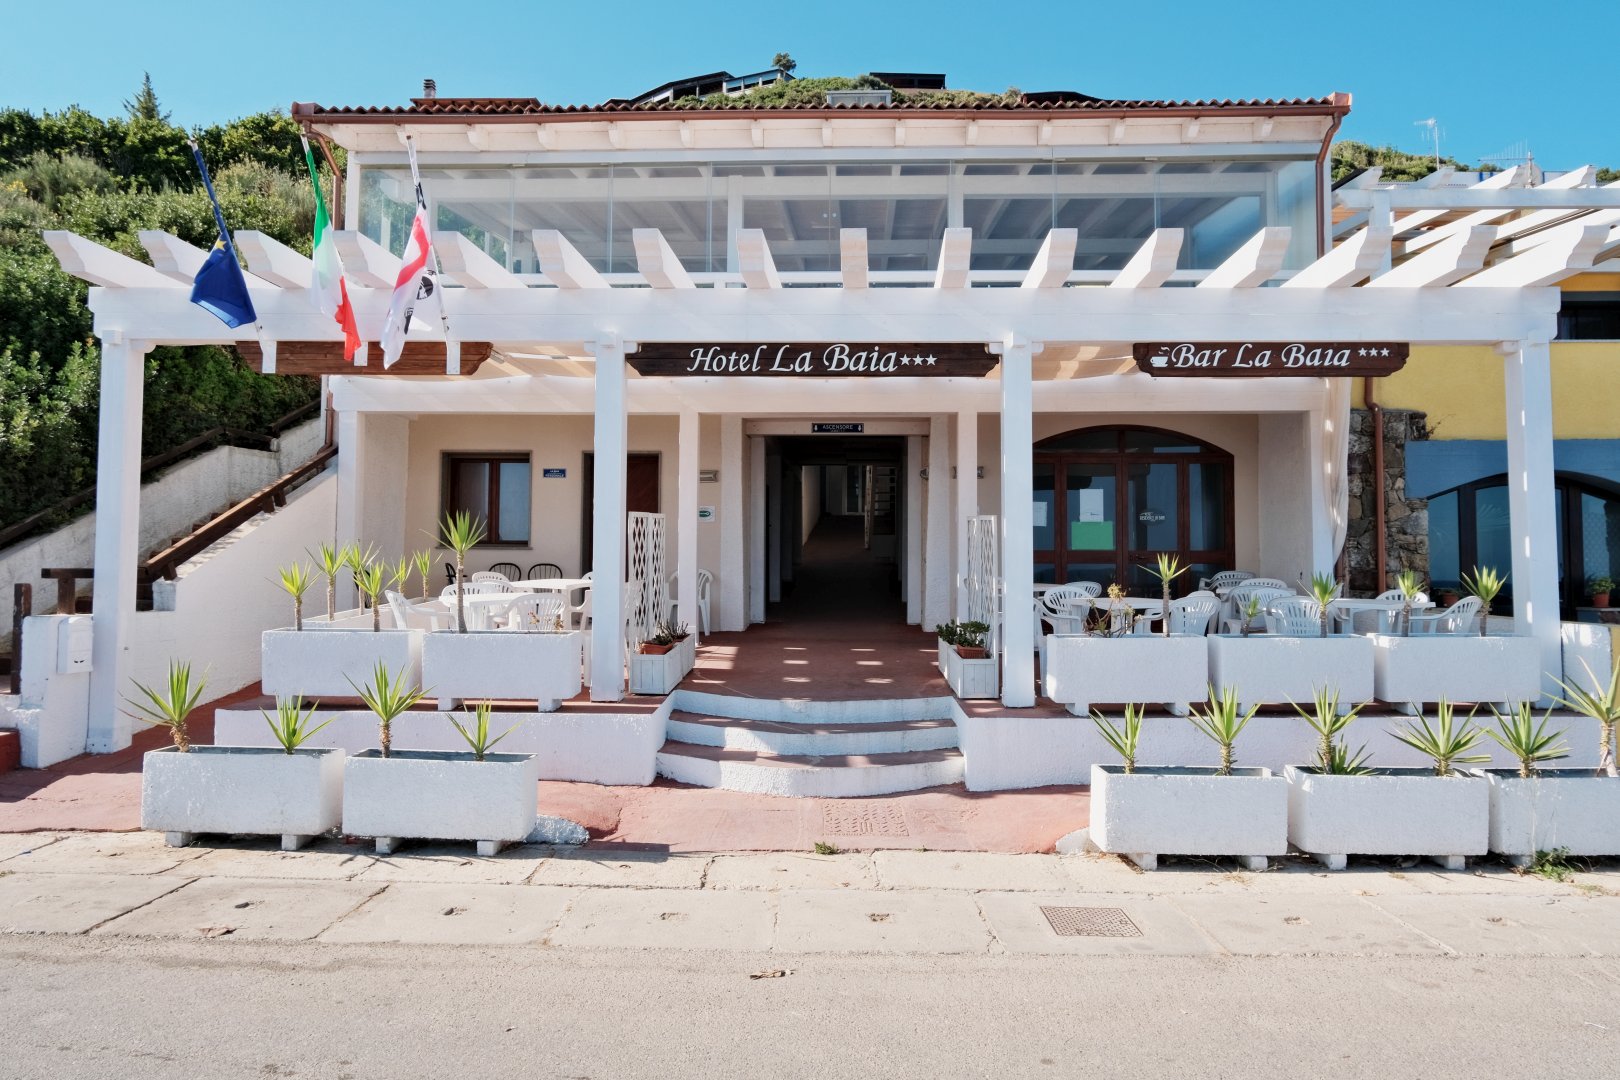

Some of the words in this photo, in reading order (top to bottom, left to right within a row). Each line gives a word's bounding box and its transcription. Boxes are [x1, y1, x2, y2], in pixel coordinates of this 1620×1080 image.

[688, 344, 768, 373] Hotel
[769, 344, 813, 373] La
[823, 344, 898, 373] Baia
[1172, 343, 1227, 368] Bar
[1232, 343, 1272, 368] La
